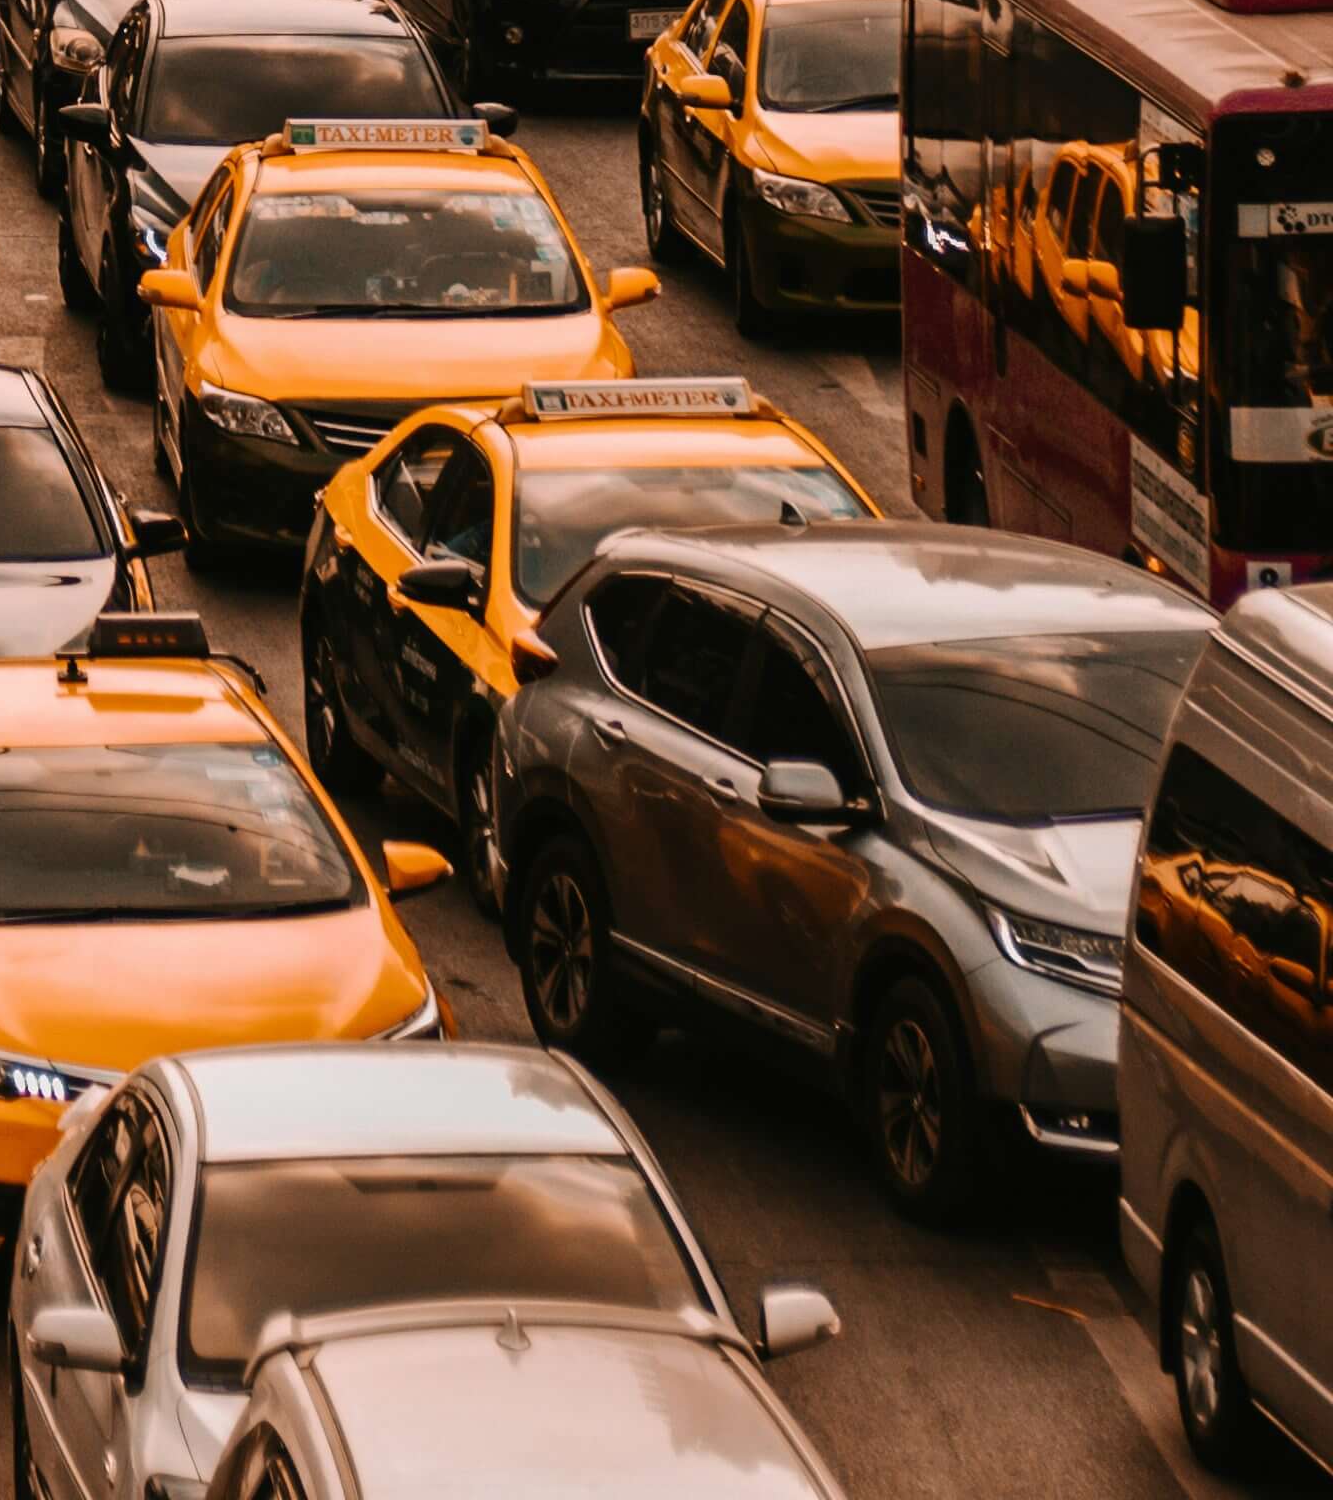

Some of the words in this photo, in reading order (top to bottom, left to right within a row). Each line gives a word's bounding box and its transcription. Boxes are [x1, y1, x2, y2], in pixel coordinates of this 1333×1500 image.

[318, 126, 454, 143] TAXI-METER
[1307, 212, 1333, 227] DT
[565, 390, 722, 409] TAXI-METER
